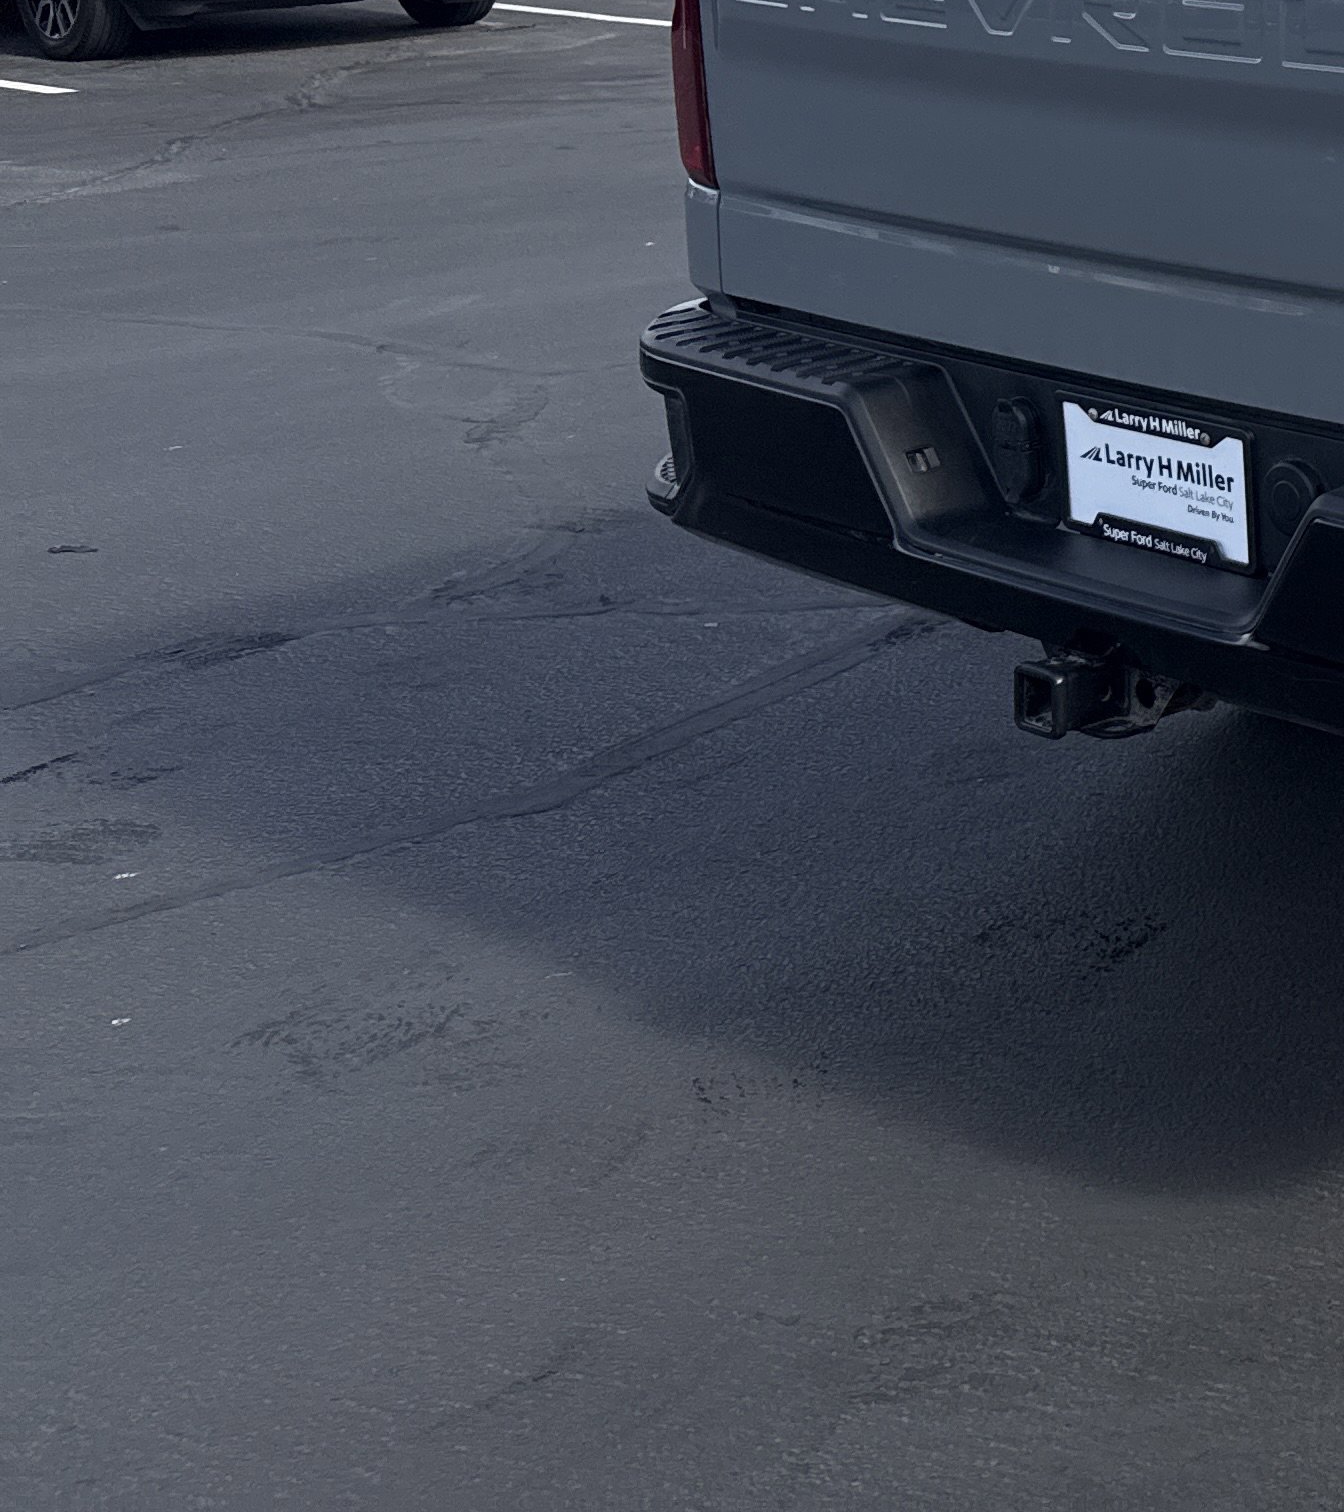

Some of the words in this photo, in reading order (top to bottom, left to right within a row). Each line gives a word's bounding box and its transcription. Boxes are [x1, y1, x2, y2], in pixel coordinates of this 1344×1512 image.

[1114, 409, 1148, 431] Larry
[1150, 416, 1160, 431] H
[1162, 420, 1200, 439] Miller
[1105, 443, 1154, 478] Larry
[1158, 456, 1172, 478] H
[1177, 460, 1234, 492] Miller
[1131, 475, 1156, 491] Super
[1158, 482, 1177, 495] Ford
[1179, 487, 1194, 500] Salt
[1196, 491, 1215, 504] Lake
[1216, 494, 1233, 511] City
[1188, 505, 1210, 518] Driven
[1211, 510, 1221, 522] By
[1221, 512, 1234, 523] You
[1103, 524, 1129, 541] Super
[1130, 531, 1153, 547] Ford
[1154, 539, 1170, 552] Salt
[1171, 543, 1190, 557] Lake
[1191, 548, 1207, 563] City
